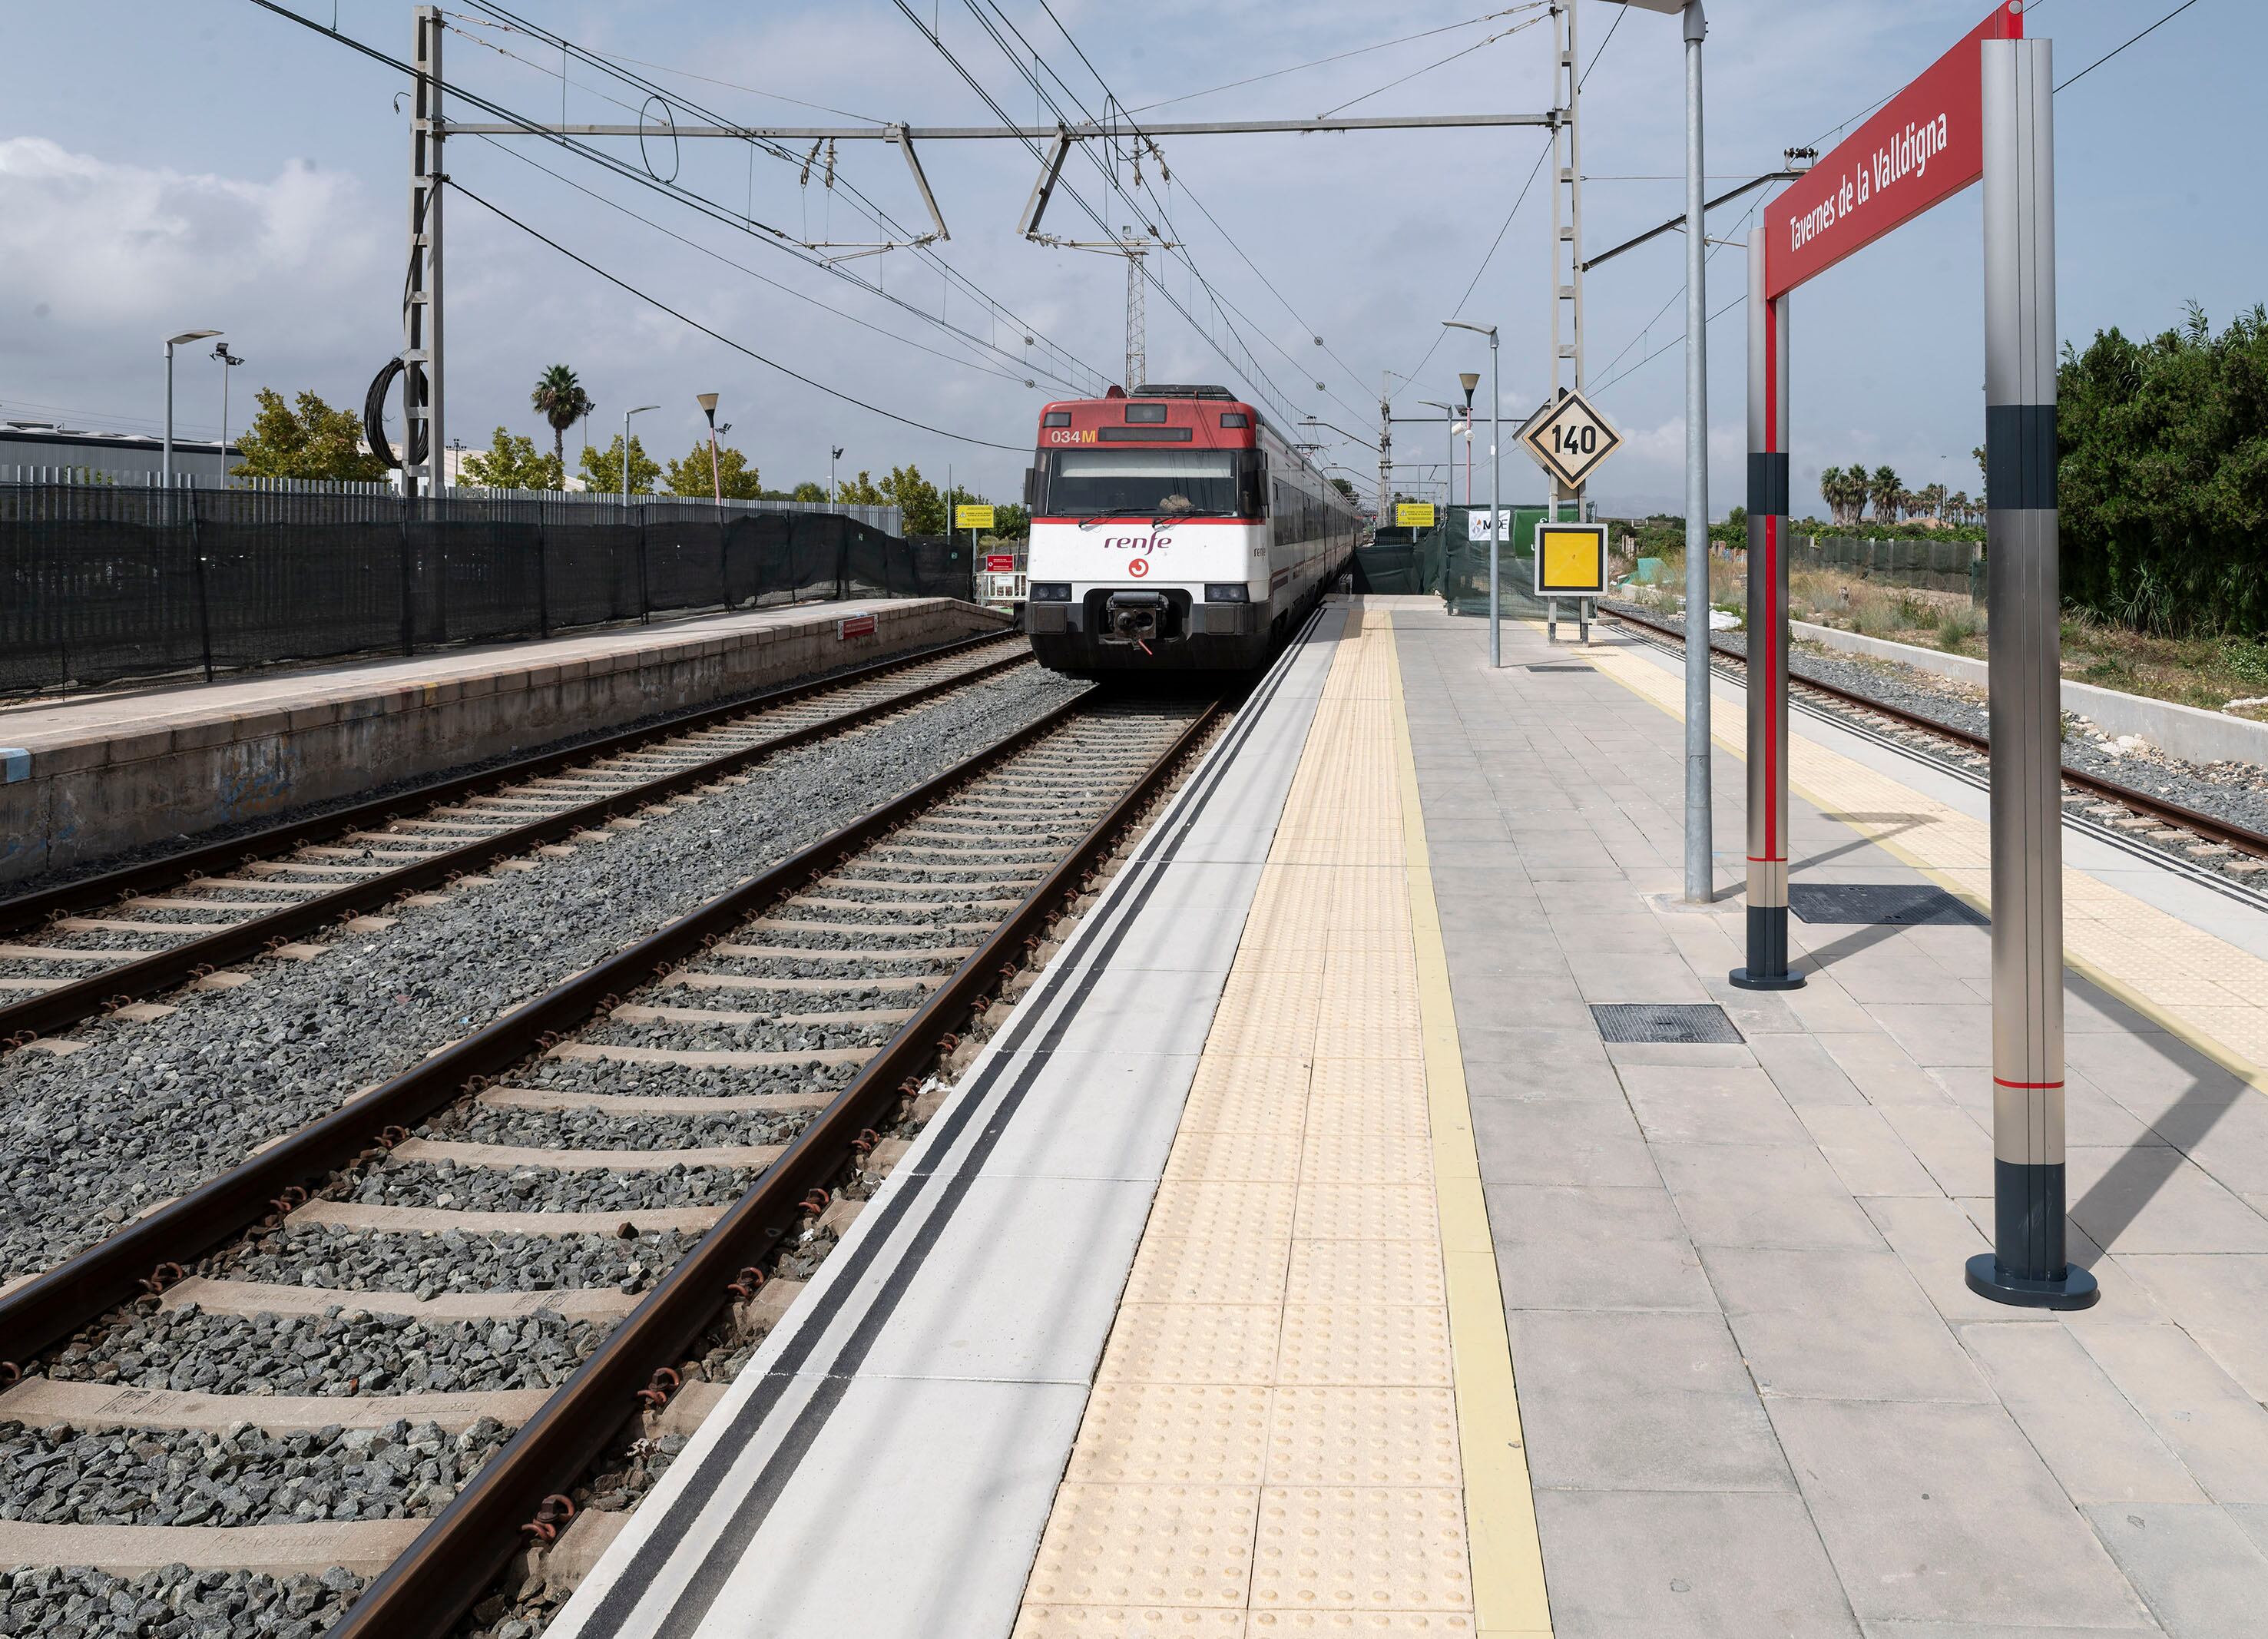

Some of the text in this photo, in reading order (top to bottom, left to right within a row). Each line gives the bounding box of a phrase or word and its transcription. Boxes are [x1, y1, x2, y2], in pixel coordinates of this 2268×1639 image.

[1790, 113, 1947, 252] Tavernes de la Valldigna
[1051, 430, 1096, 443] 034M
[1552, 425, 1596, 455] 140
[1104, 530, 1172, 555] renfe
